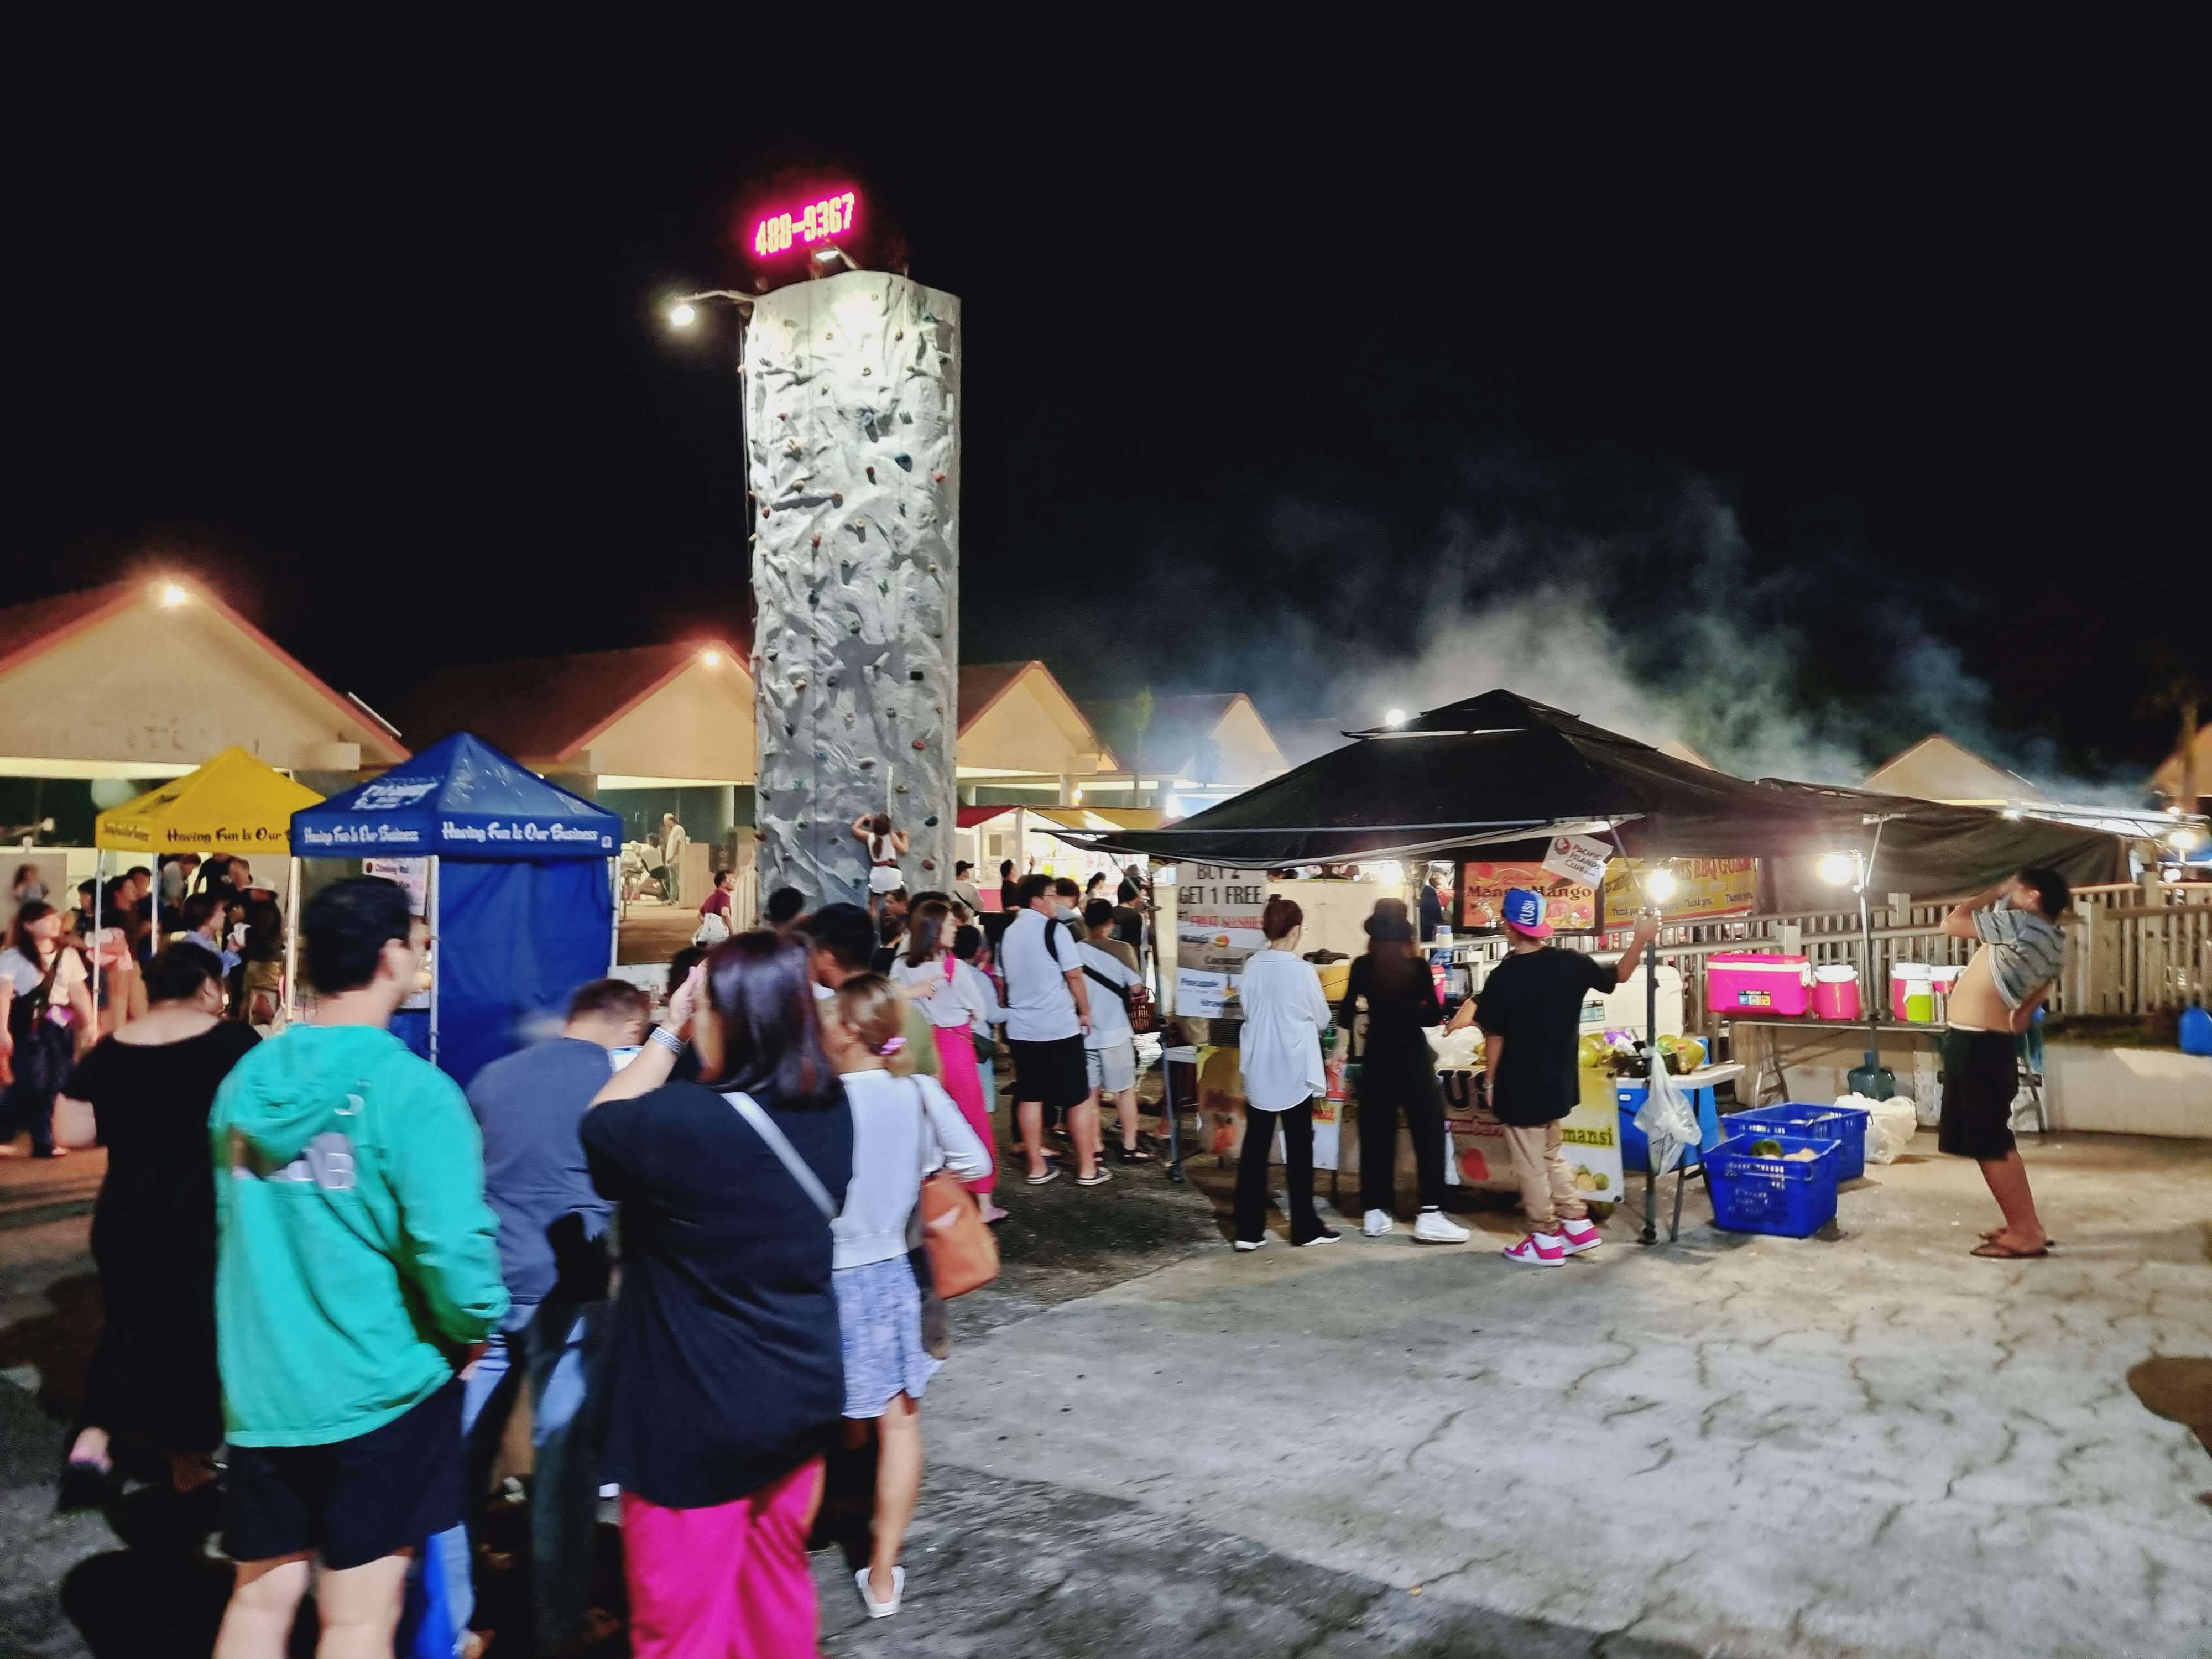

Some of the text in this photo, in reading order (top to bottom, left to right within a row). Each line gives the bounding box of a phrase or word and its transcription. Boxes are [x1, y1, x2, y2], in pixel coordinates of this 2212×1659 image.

[755, 192, 855, 256] 488-9367
[168, 828, 211, 843] Having
[216, 827, 239, 841] Fun
[255, 827, 281, 840] Our
[442, 821, 486, 842] Having
[488, 822, 510, 839] Fun
[524, 822, 549, 840] Our
[550, 822, 599, 840] Business
[1570, 852, 1602, 869] ISLANDS
[1573, 844, 1603, 860] PACIFIC
[1564, 859, 1585, 872] CLUB
[1179, 886, 1262, 904] GET 1 FREE
[1531, 885, 1593, 901] Mango
[1519, 900, 1536, 925] KUSH
